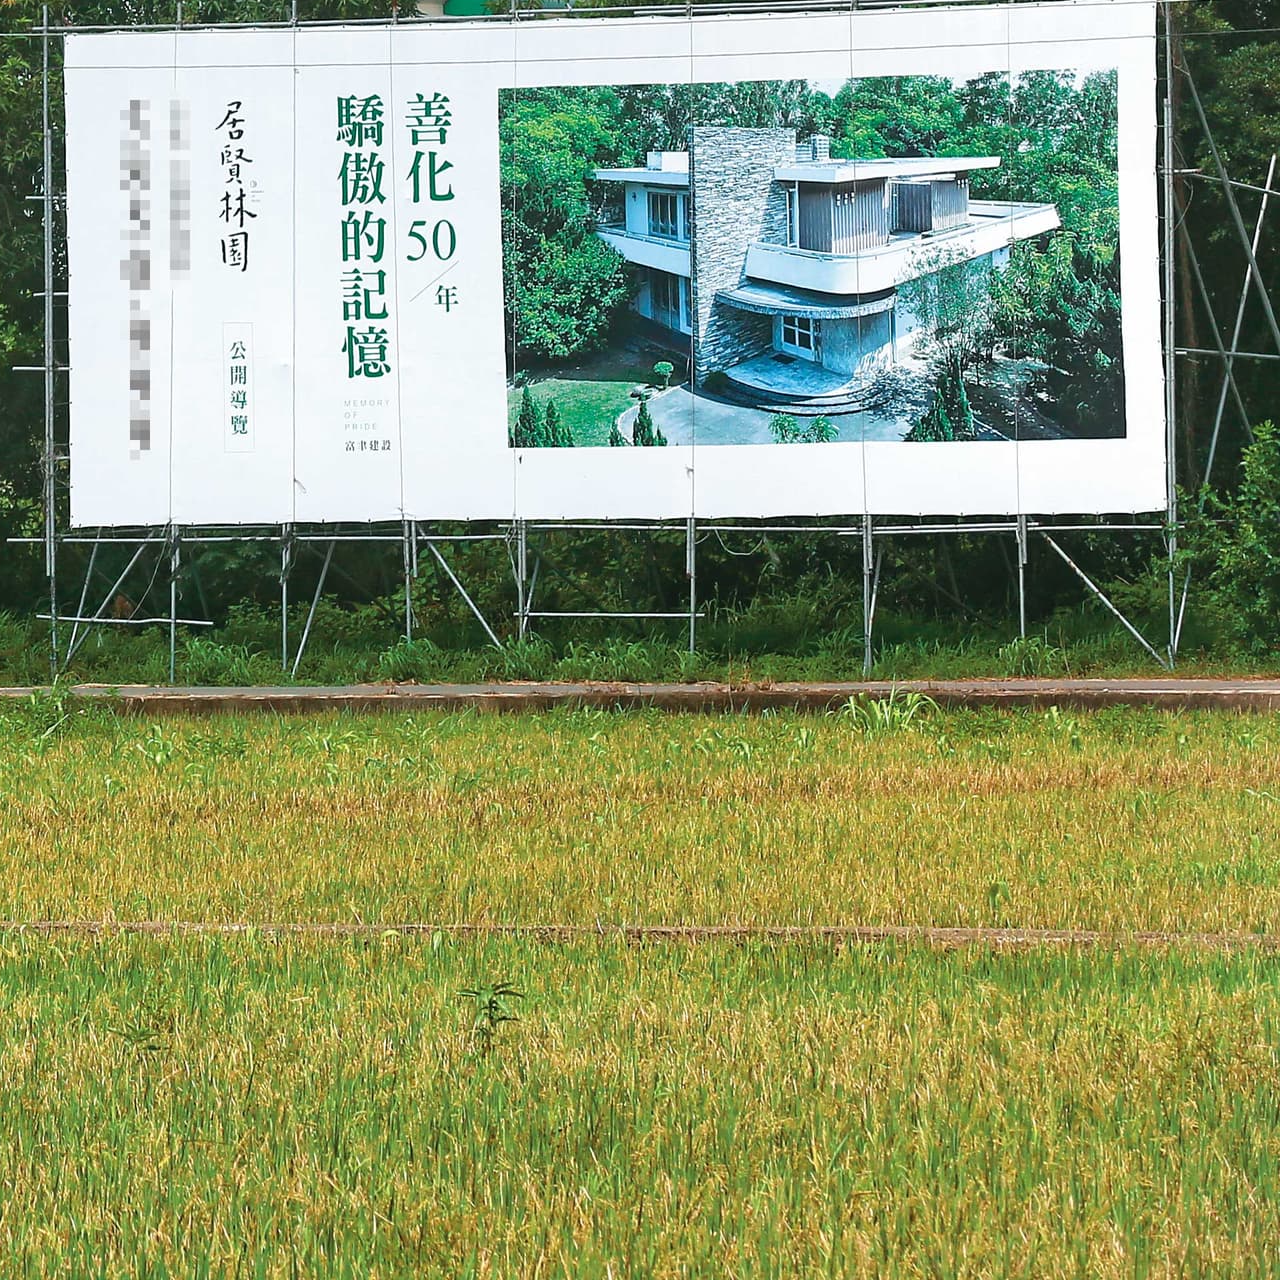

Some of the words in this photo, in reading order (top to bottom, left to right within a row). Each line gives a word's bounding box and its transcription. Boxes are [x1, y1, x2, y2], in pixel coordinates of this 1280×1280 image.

[215, 100, 258, 273] 居賢林園
[336, 94, 392, 380] 驕傲的記憶
[229, 341, 248, 436] 公開導覽
